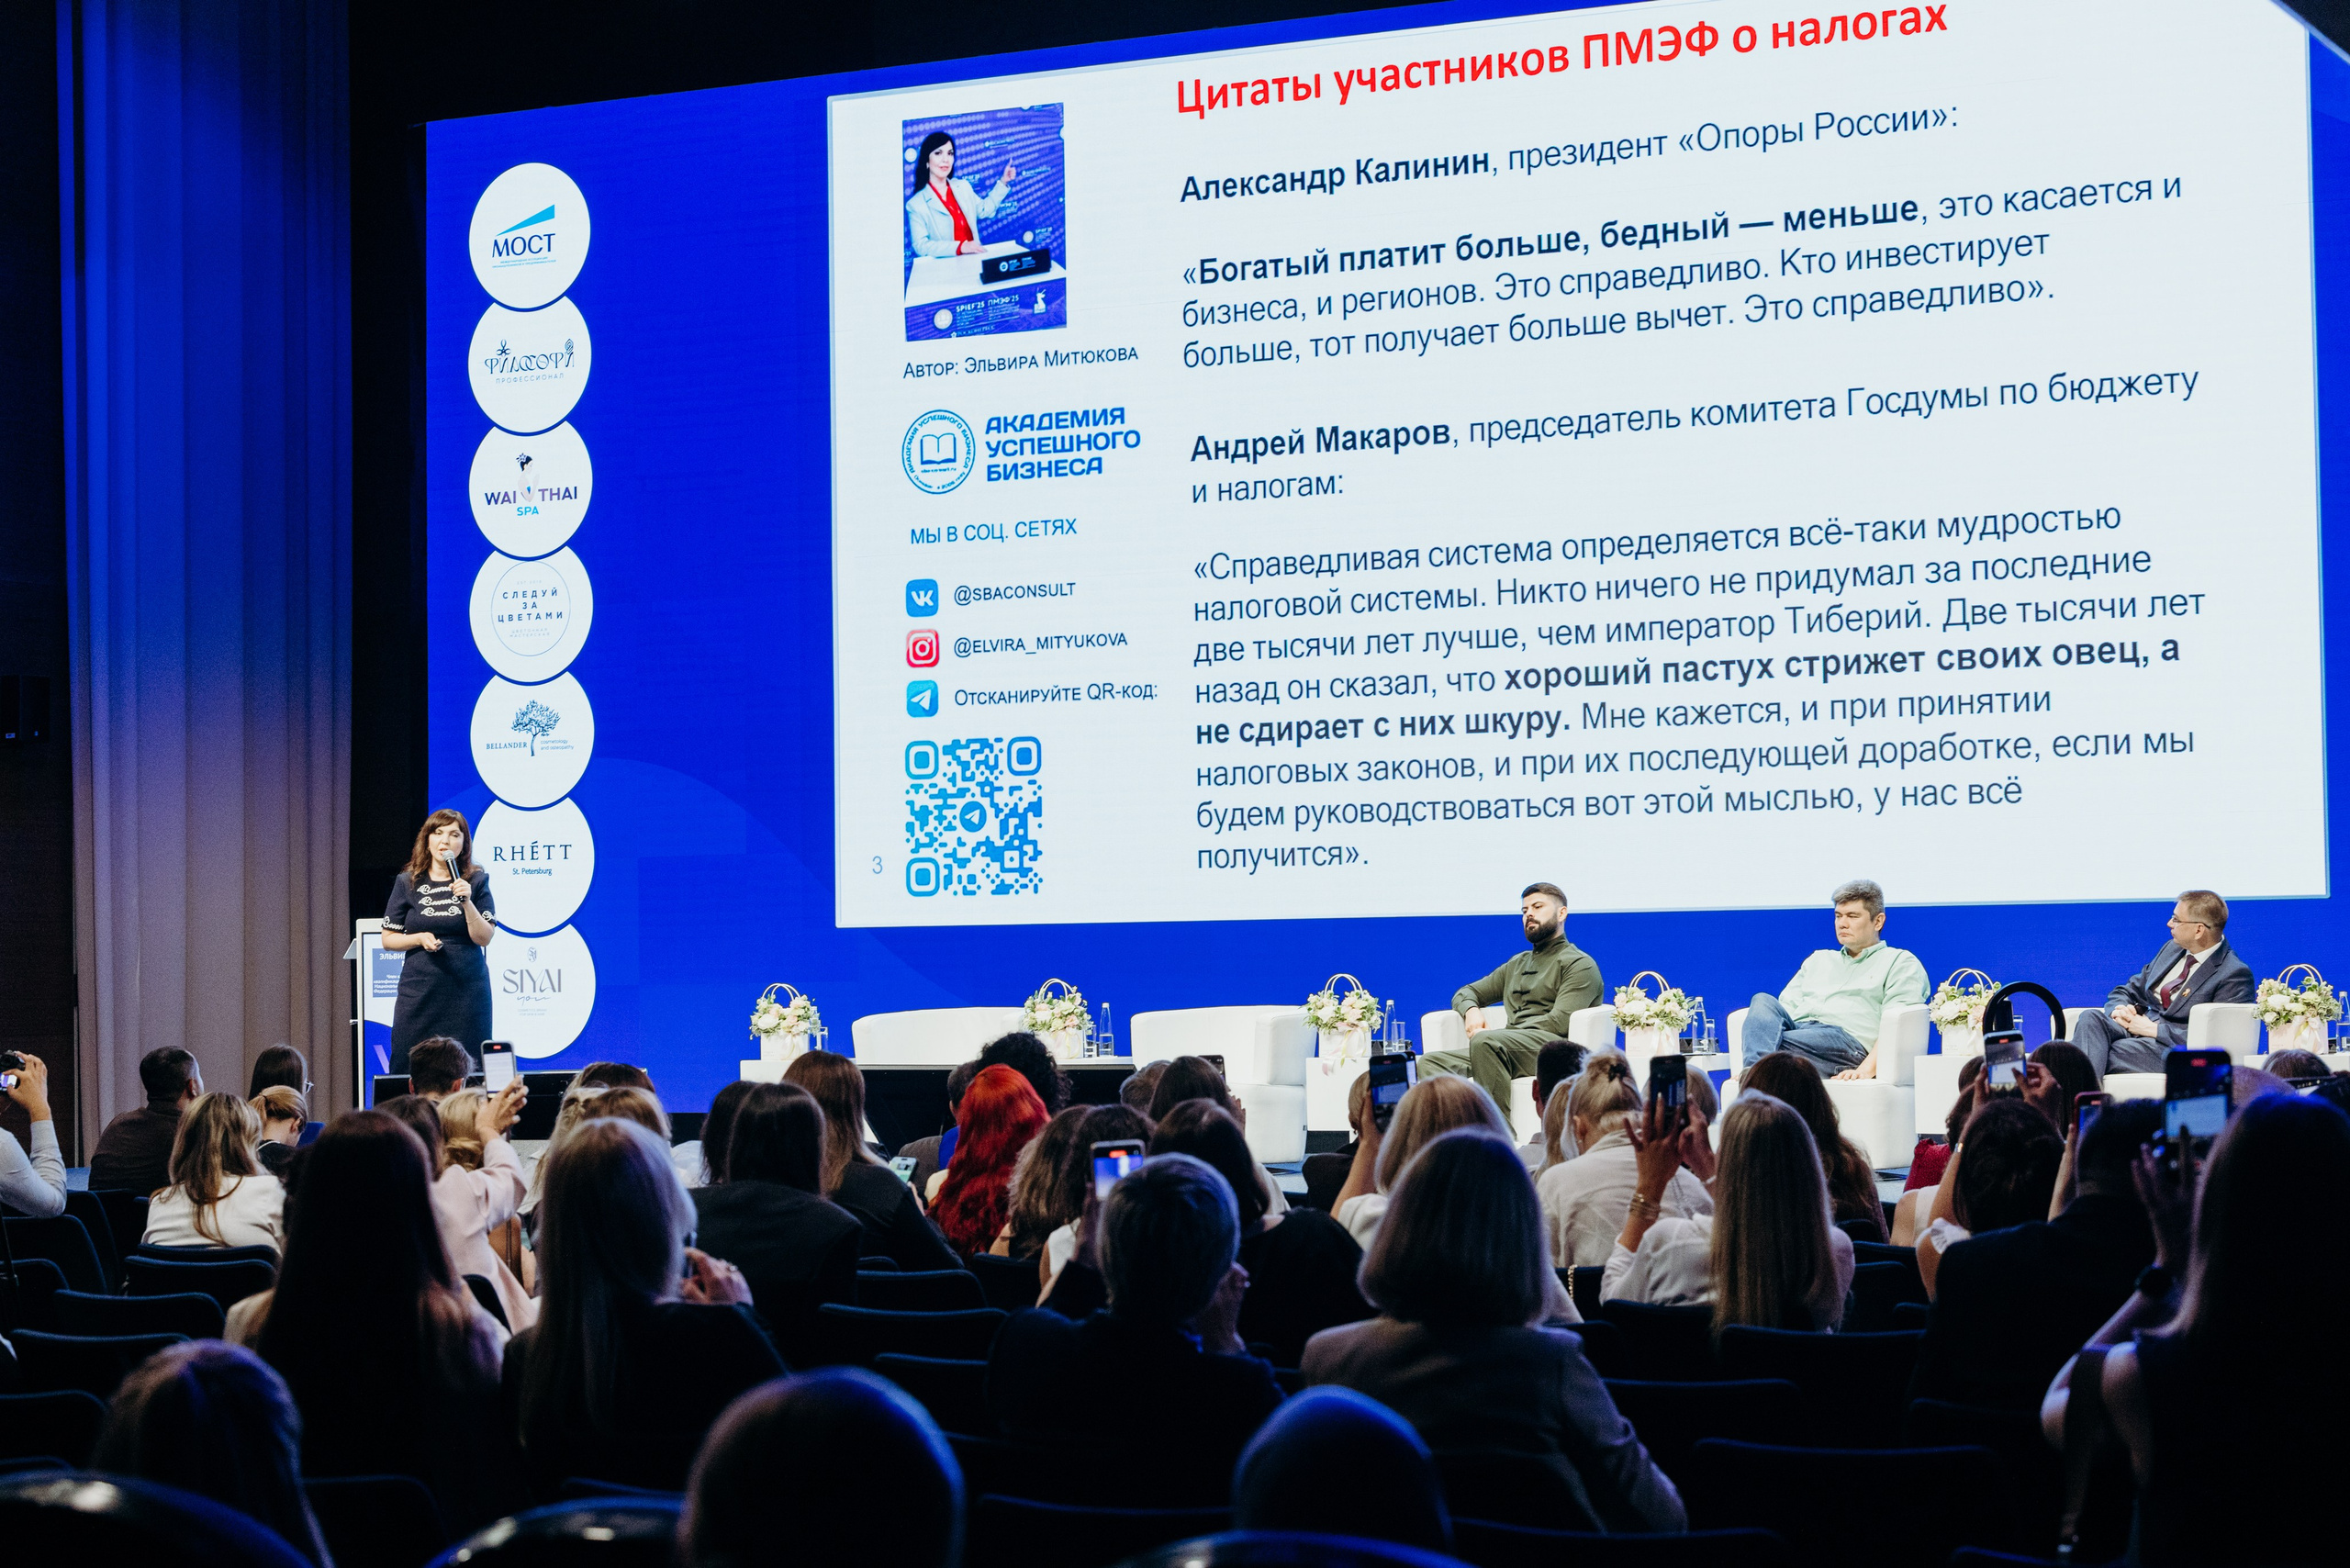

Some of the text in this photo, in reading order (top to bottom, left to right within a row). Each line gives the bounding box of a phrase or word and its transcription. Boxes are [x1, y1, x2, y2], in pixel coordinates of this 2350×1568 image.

[1177, 4, 1948, 120] Цитаты участников ПМЭФ о налогах
[1179, 106, 1958, 204] Александр Калинин, президент «Опоры России»:
[1182, 247, 1329, 286] «Богатый
[1338, 242, 1447, 273] платит
[1455, 230, 1590, 262] больше,
[1600, 210, 1729, 252] бедный
[1783, 199, 1928, 233] меньше,
[1938, 193, 1994, 220] это
[2003, 179, 2153, 214] касается
[2163, 176, 2182, 199] и
[492, 233, 555, 258] МОСТ
[1182, 233, 2051, 328] бизнеса, и регионов. Это справедливо. Кто инвестирует
[1182, 279, 2054, 369] больше, тот получает больше вычет. Это справедливо».
[496, 373, 565, 385] ПРОФЕССИОНАЛ
[985, 407, 1125, 435] АКАДЕМИЯ
[1190, 370, 2200, 465] Андрей Макаров, председатель комитета Госдумы по бюджету
[985, 430, 1141, 458] УСПЕШНОГО
[987, 456, 1102, 482] БИЗНЕСА
[485, 486, 577, 506] WAI THAI
[1192, 474, 1344, 504] и налогам:
[516, 506, 539, 517] SPA
[911, 518, 1077, 544] МЫ В СОЦ. СЕТЯХ
[1193, 506, 2121, 585] «Справедливая система определяется всё-таки мудростью
[502, 588, 558, 599] СЛЕДУЙ
[1194, 550, 2153, 622] налоговой системы. Никто ничего не придумал за последние
[498, 611, 564, 623] ЦВЕТАМИ
[522, 601, 538, 610] ЗА
[1192, 593, 2207, 668] две тысячи лет лучше, чем император Тиберий. Две тысячи лет
[1195, 638, 2180, 706] назад он сказал, что хороший пастух стрижет своих овец, а
[1196, 690, 2052, 749] не сдирает с них шкуру. Мне кажется, и при принятии
[486, 742, 528, 750] BELLANDER
[1196, 731, 2194, 787] налоговых законов, и при их последующей доработке, если мы
[1196, 775, 2023, 835] будем руководствоваться вот этой мыслью, у нас всё
[493, 841, 572, 862] RHÉTT
[871, 856, 883, 875] 3
[1197, 845, 1369, 876] получится».
[521, 868, 553, 877] Petersburg
[502, 969, 562, 993] SIYAI
